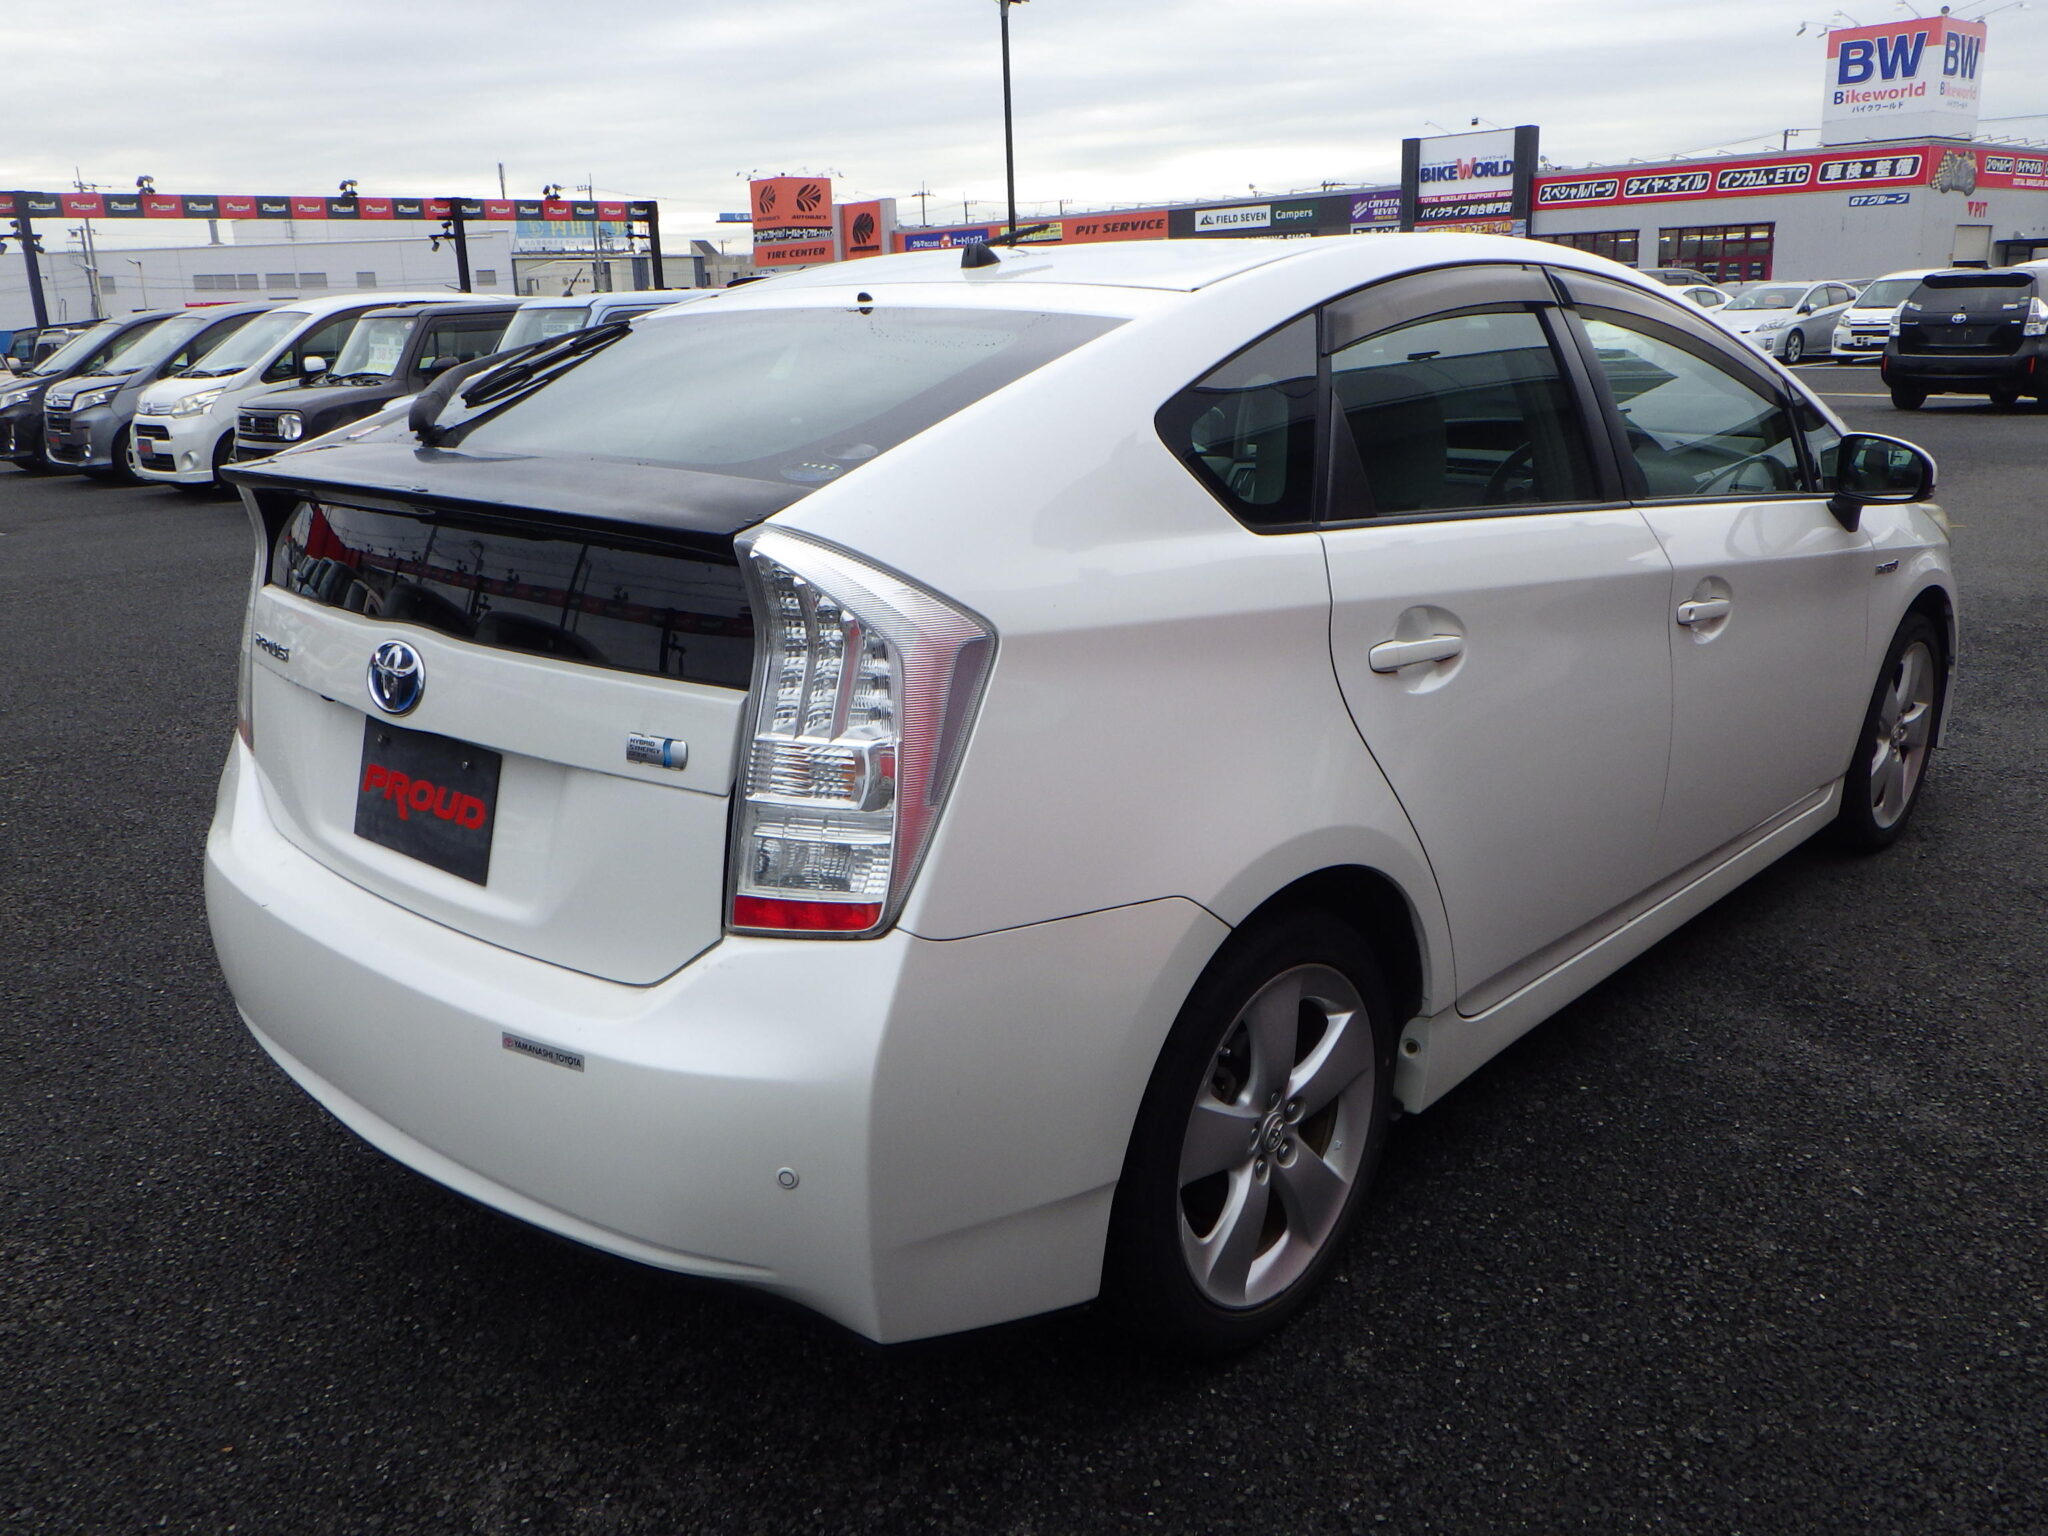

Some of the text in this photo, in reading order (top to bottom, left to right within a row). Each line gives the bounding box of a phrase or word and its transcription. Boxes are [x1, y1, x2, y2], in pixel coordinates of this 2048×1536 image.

[1838, 31, 1929, 86] BW
[1942, 31, 1981, 80] BW
[1833, 82, 1926, 105] Bikeworld
[1852, 101, 1904, 113] バイクワールド
[1420, 157, 1514, 183] BIKEWORLD
[1720, 166, 1808, 189] インカム・ETC
[1541, 181, 1616, 200] スペシャルパーツ
[1628, 174, 1707, 195] タイヤ・オイル
[1850, 194, 1908, 206] G7グループ
[1216, 212, 1267, 224] FIELD SEVEN
[1275, 208, 1313, 220] Campers
[1373, 207, 1399, 216] SEVEN
[1421, 202, 1512, 218] バイクライフ総合専門店
[1075, 222, 1099, 235] PIT
[1102, 219, 1165, 234] SERVICE
[767, 247, 826, 260] TIRE CENTER
[629, 737, 656, 747] HYBRID
[629, 744, 661, 754] SYNERGY
[362, 763, 487, 831] PROUD
[514, 1039, 581, 1067] YAMANASHI TOYOTA
